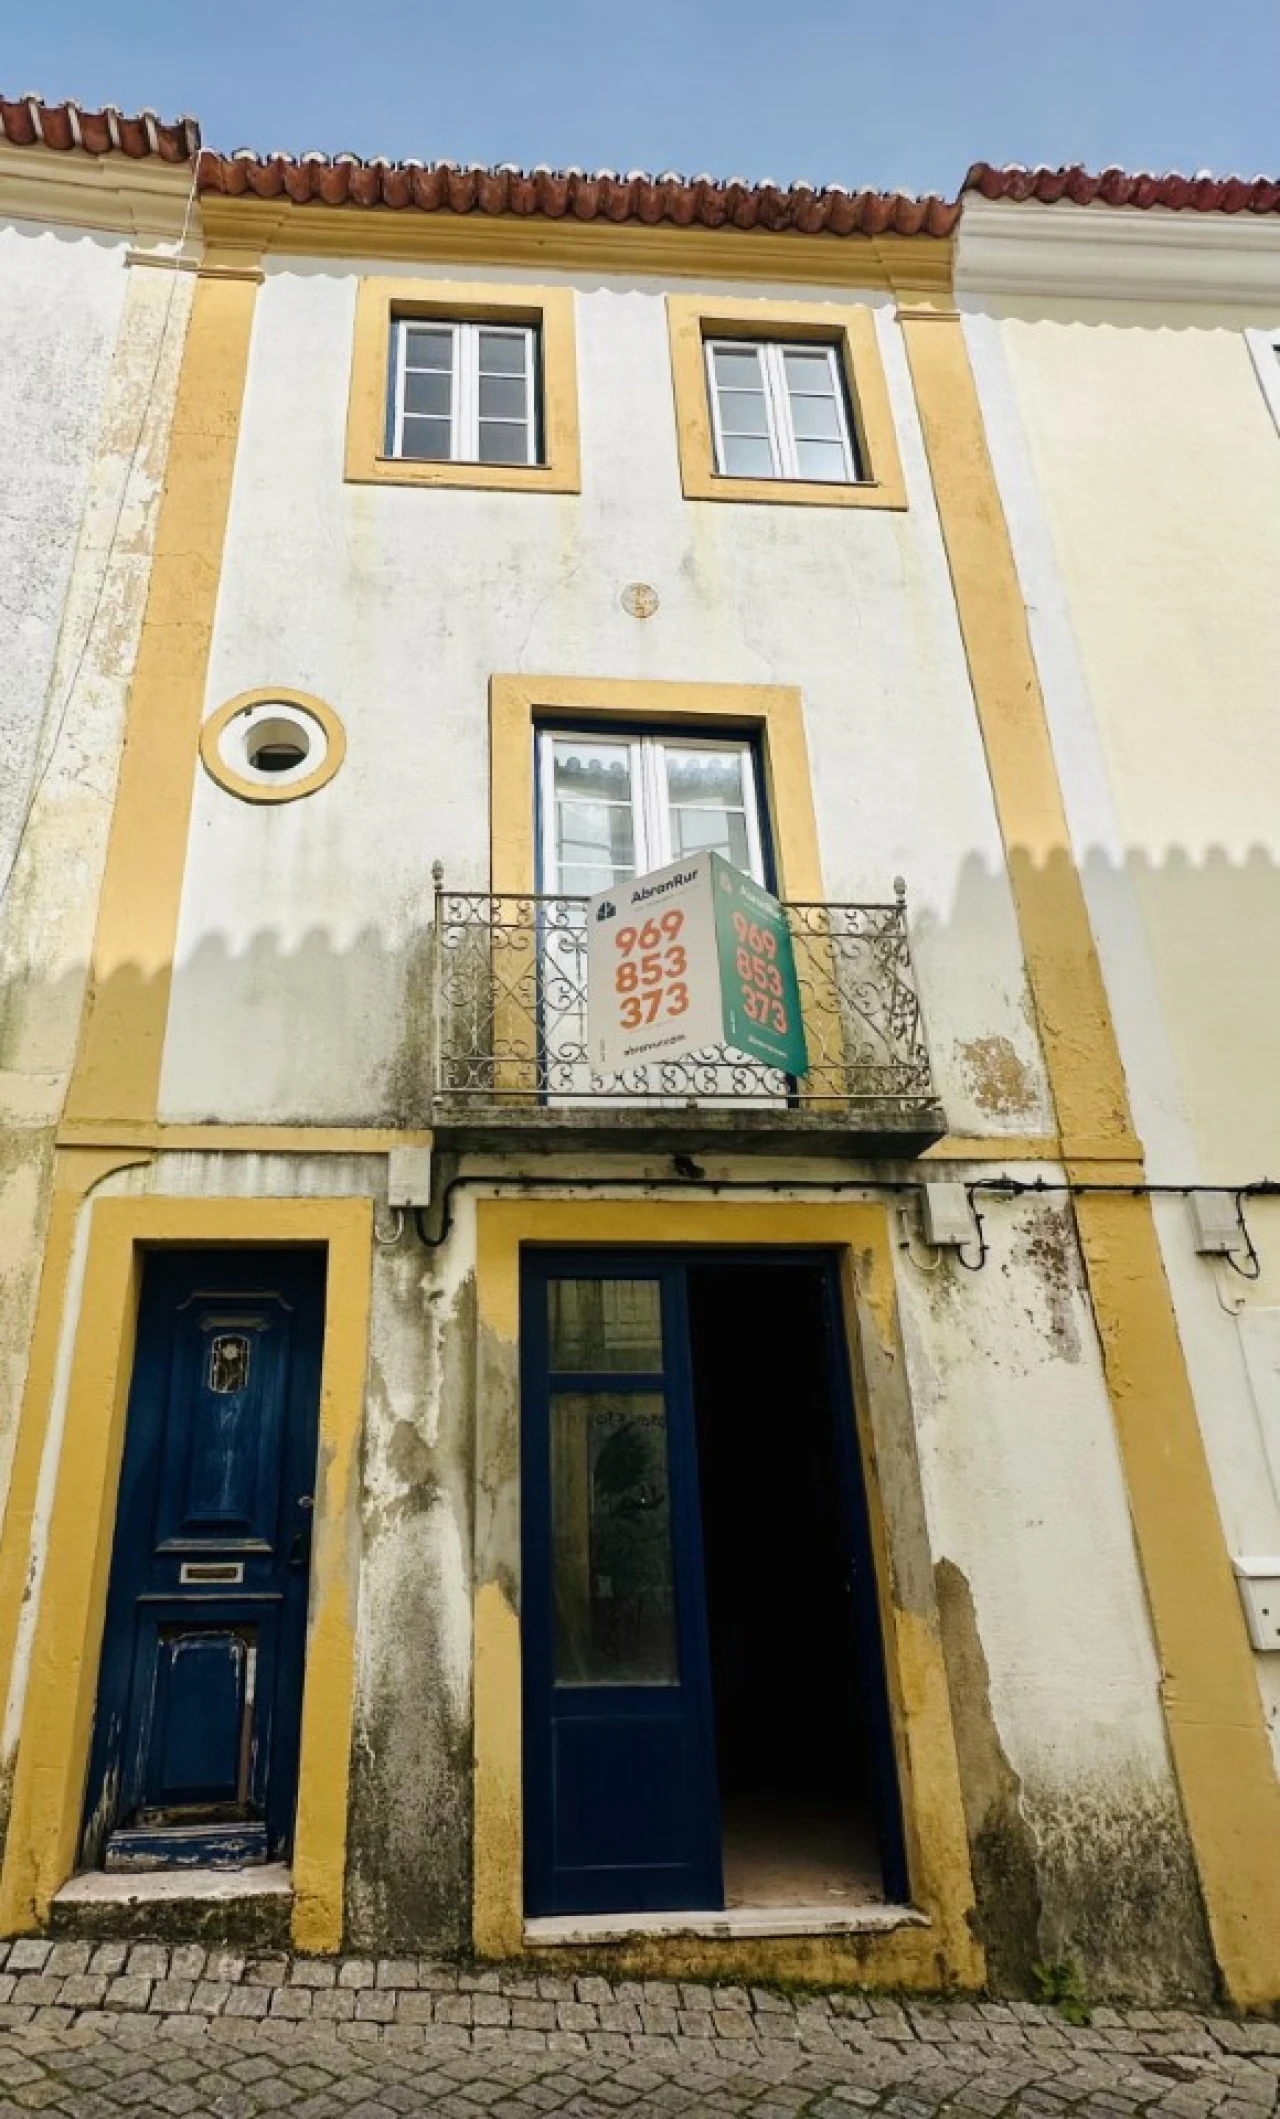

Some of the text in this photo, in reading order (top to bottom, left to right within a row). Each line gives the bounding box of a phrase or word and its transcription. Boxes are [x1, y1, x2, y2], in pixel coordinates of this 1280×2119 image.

[631, 869, 699, 905] AbranRur
[615, 909, 684, 957] 969
[733, 910, 777, 958] 969
[615, 945, 687, 993] 853
[736, 946, 782, 998] 853
[620, 982, 689, 1029] 373
[742, 984, 788, 1034] 373
